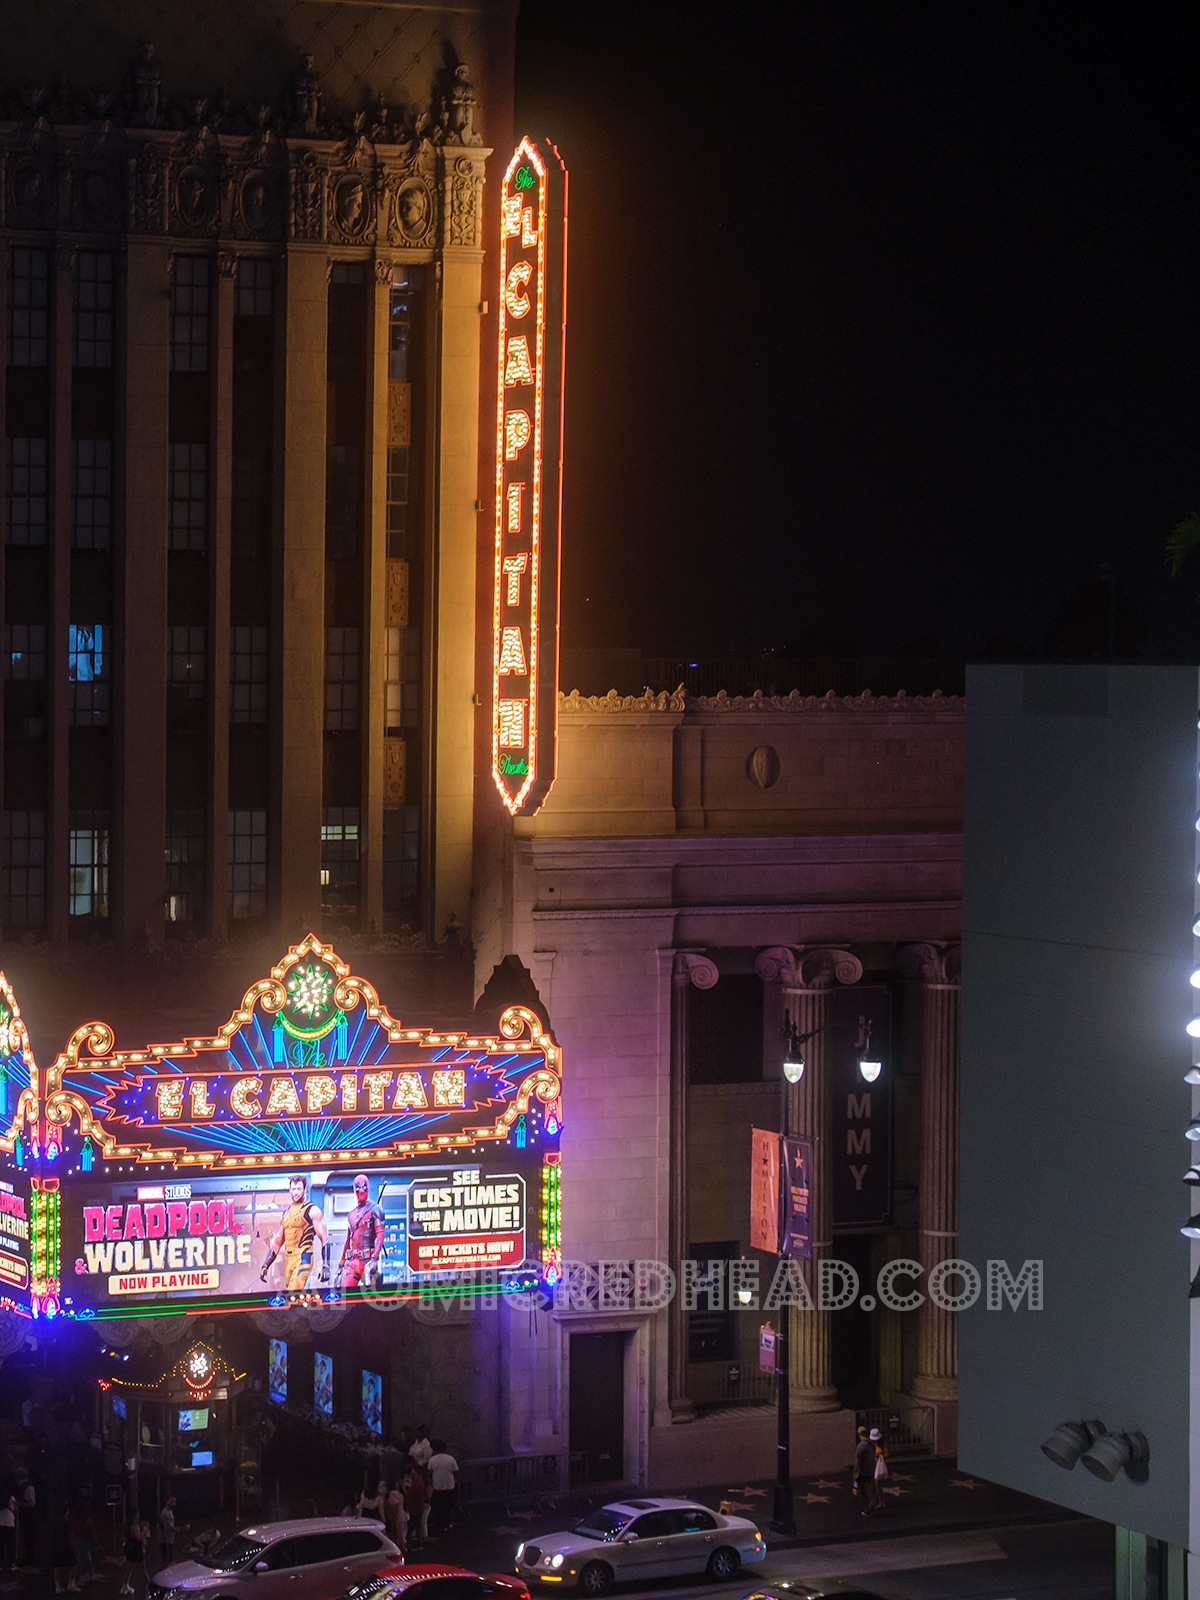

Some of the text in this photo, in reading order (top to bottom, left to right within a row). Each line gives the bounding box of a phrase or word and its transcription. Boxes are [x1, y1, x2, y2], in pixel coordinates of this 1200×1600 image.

[515, 166, 535, 190] The
[499, 192, 538, 748] EL CAPITAN
[290, 1039, 328, 1068] The
[156, 1070, 466, 1120] EL CAPITAN
[452, 1170, 480, 1186] SEE
[165, 1184, 192, 1199] STUDIOS
[413, 1184, 520, 1209] COSTUMES
[83, 1199, 244, 1242] DEADPOOL
[413, 1210, 440, 1222] FROM
[422, 1221, 440, 1232] THE
[443, 1206, 520, 1231] MOVIE!
[84, 1235, 252, 1275] WOLVERINE
[418, 1240, 514, 1257] GET TICKETS NOW!
[119, 1273, 209, 1290] NOW PLAYING
